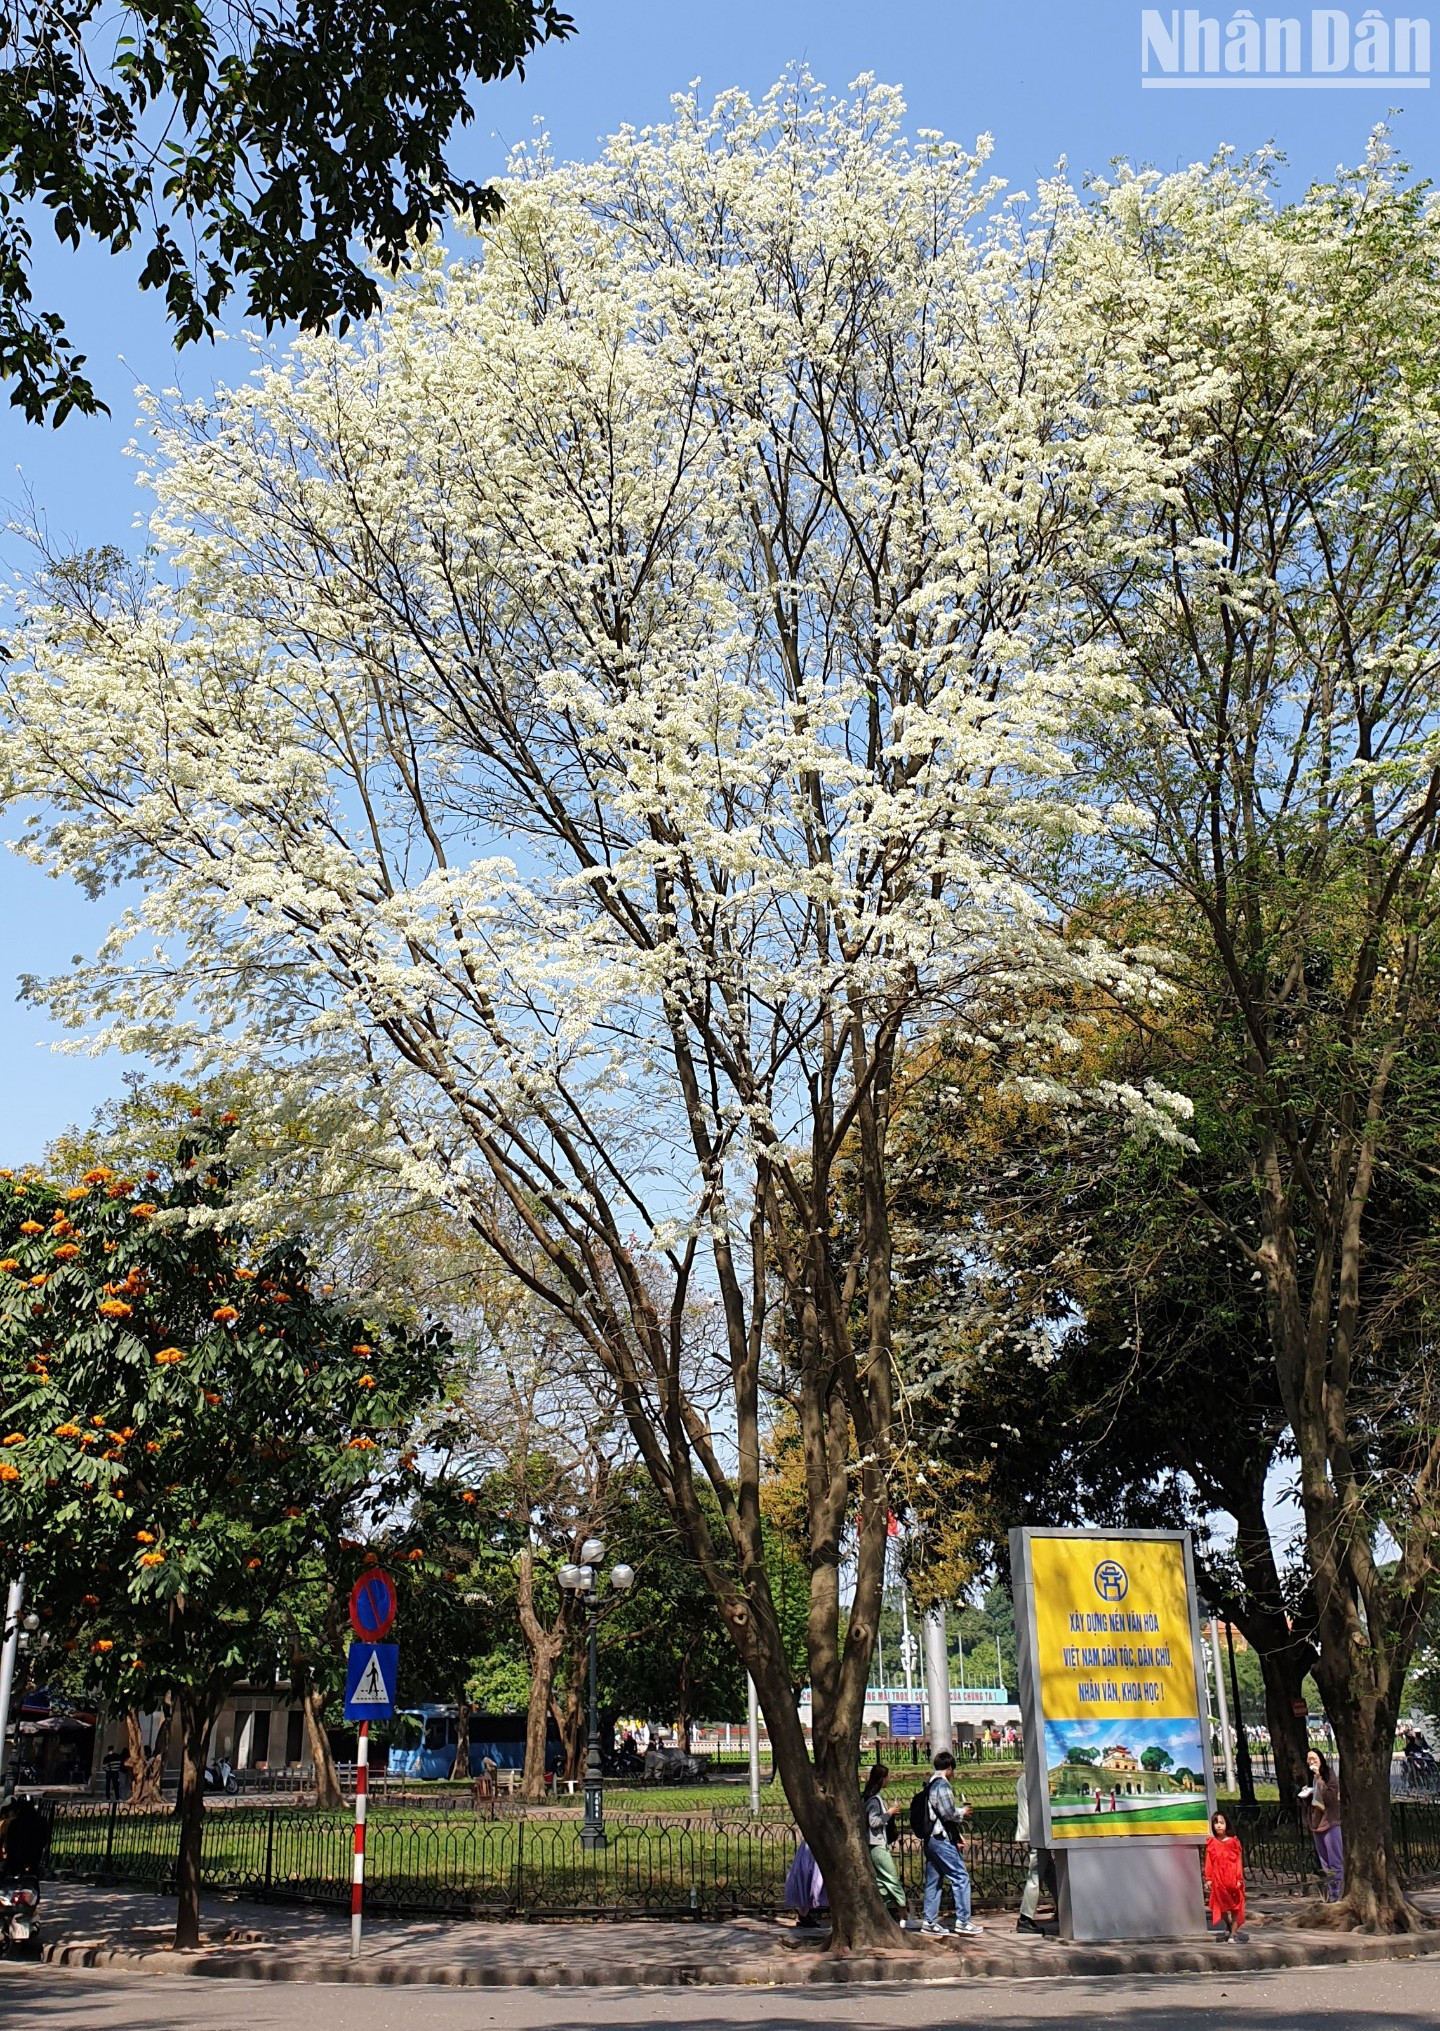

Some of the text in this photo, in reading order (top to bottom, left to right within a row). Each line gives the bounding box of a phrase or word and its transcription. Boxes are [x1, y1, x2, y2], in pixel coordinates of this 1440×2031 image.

[1070, 1610, 1084, 1632] XÂY
[1086, 1611, 1107, 1636] DỰNG
[1126, 1610, 1142, 1632] VĂN
[1143, 1610, 1159, 1632] HÓA
[1063, 1641, 1173, 1671] VIỆT NAM DÂN TỘC, DÂN CHỦ,
[1079, 1679, 1100, 1701] NHÂN
[1102, 1678, 1120, 1703] VĂN,
[1121, 1682, 1142, 1701] KHOA
[1143, 1682, 1159, 1705] HỌC
